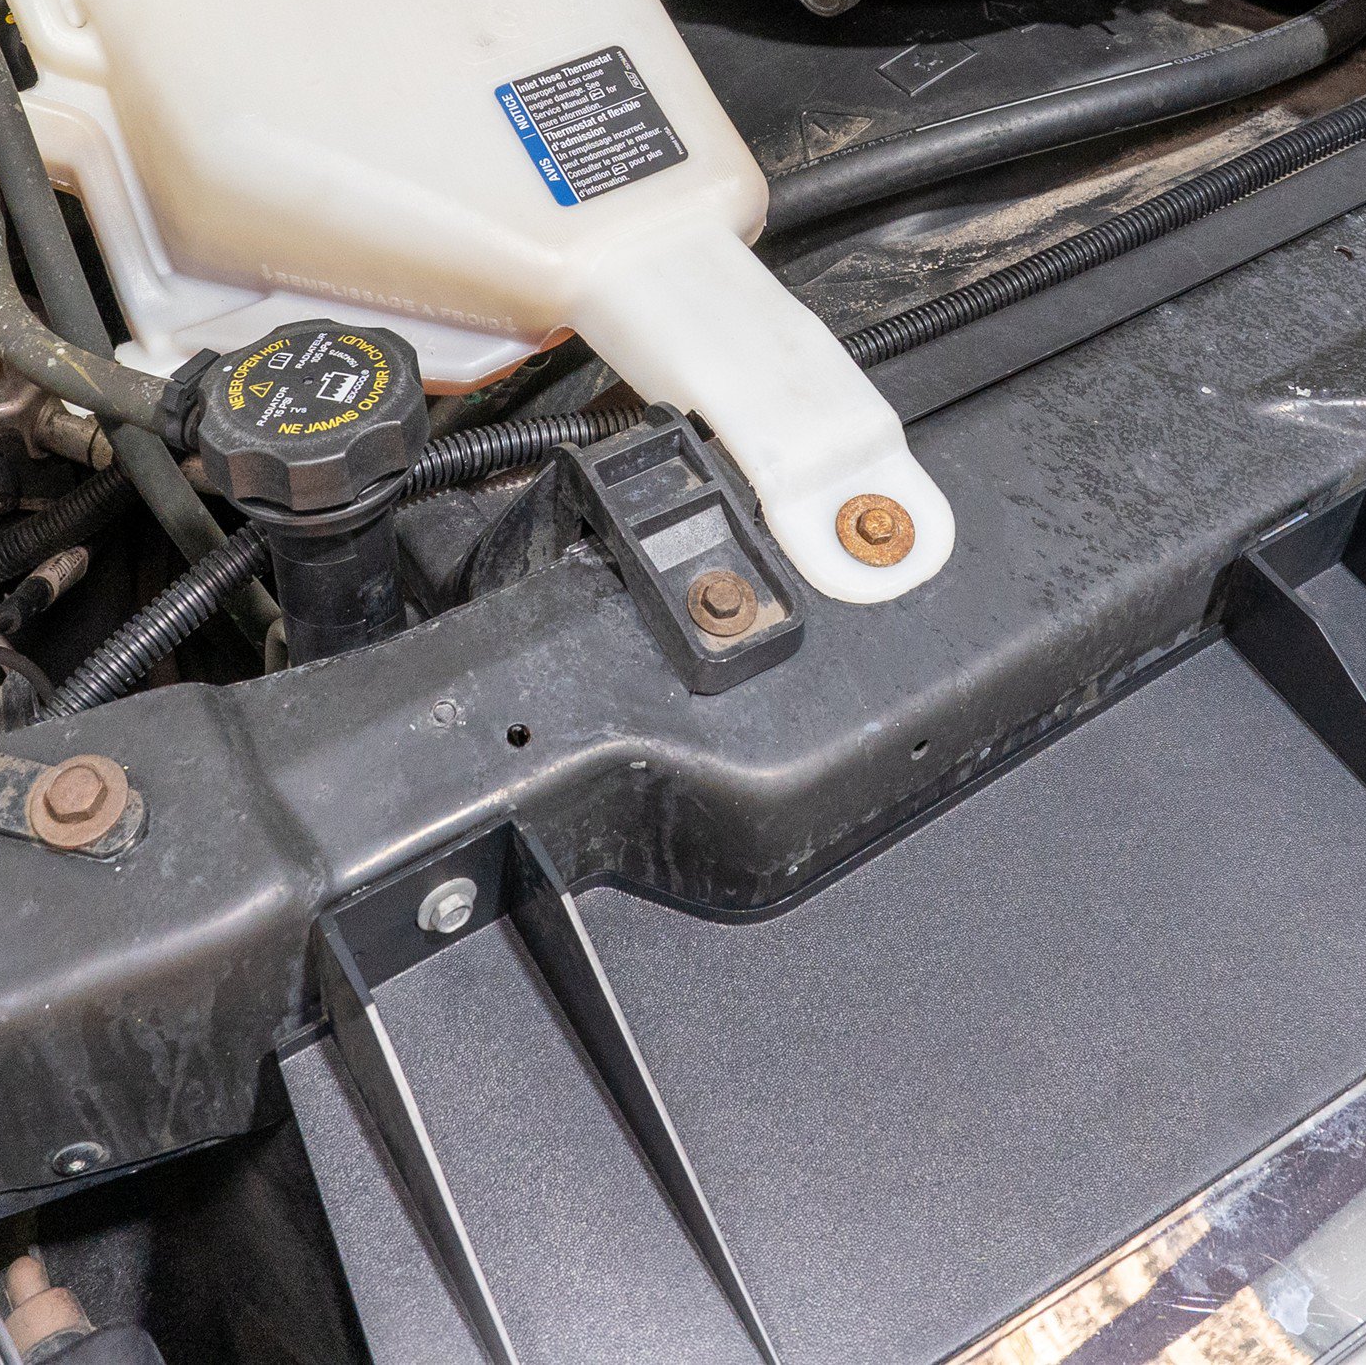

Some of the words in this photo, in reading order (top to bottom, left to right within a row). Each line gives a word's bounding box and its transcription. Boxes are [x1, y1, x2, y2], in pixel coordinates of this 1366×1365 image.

[517, 78, 539, 93] Inlet
[539, 71, 562, 87] Hose
[562, 53, 613, 79] Thermostat
[522, 86, 556, 103] Improper
[557, 81, 567, 91] fill
[568, 78, 583, 88] can
[583, 68, 604, 82] cause
[502, 93, 530, 130] NOTICE
[529, 94, 553, 112] engine
[587, 80, 601, 91] See
[533, 105, 562, 121] Service
[562, 95, 589, 111] Manual
[606, 85, 618, 94] for
[539, 118, 559, 130] more
[559, 102, 603, 126] information.
[545, 117, 597, 142] Thermostat
[597, 113, 608, 123] et
[608, 99, 641, 119] flexible
[551, 126, 606, 152] d'admission
[557, 151, 568, 162] Un
[568, 136, 613, 158] remplissage
[613, 122, 646, 140] incorrect
[562, 159, 580, 172] peut
[580, 139, 626, 166] endommager
[626, 137, 634, 146] le
[635, 126, 663, 143] moteur.
[539, 157, 561, 182] AVIS
[568, 162, 604, 180] Consulter
[604, 157, 611, 167] le
[611, 147, 639, 164] manuel
[639, 142, 650, 153] de
[573, 169, 611, 189] réparation
[628, 156, 646, 169] pour
[647, 149, 663, 163] plus
[440, 306, 500, 331] FROID
[259, 339, 291, 359] HOT!
[295, 333, 328, 369] RADIATEUR
[338, 334, 383, 360] CHAUD!
[374, 359, 388, 368] A
[236, 354, 263, 379] OPEN
[228, 378, 246, 411] NEVER
[358, 368, 390, 411] OUVRIR
[256, 386, 289, 427] RADIATOR
[273, 408, 285, 418] 15
[279, 396, 294, 411] PSI
[304, 410, 359, 434] JAMAIS
[278, 422, 302, 435] NE
